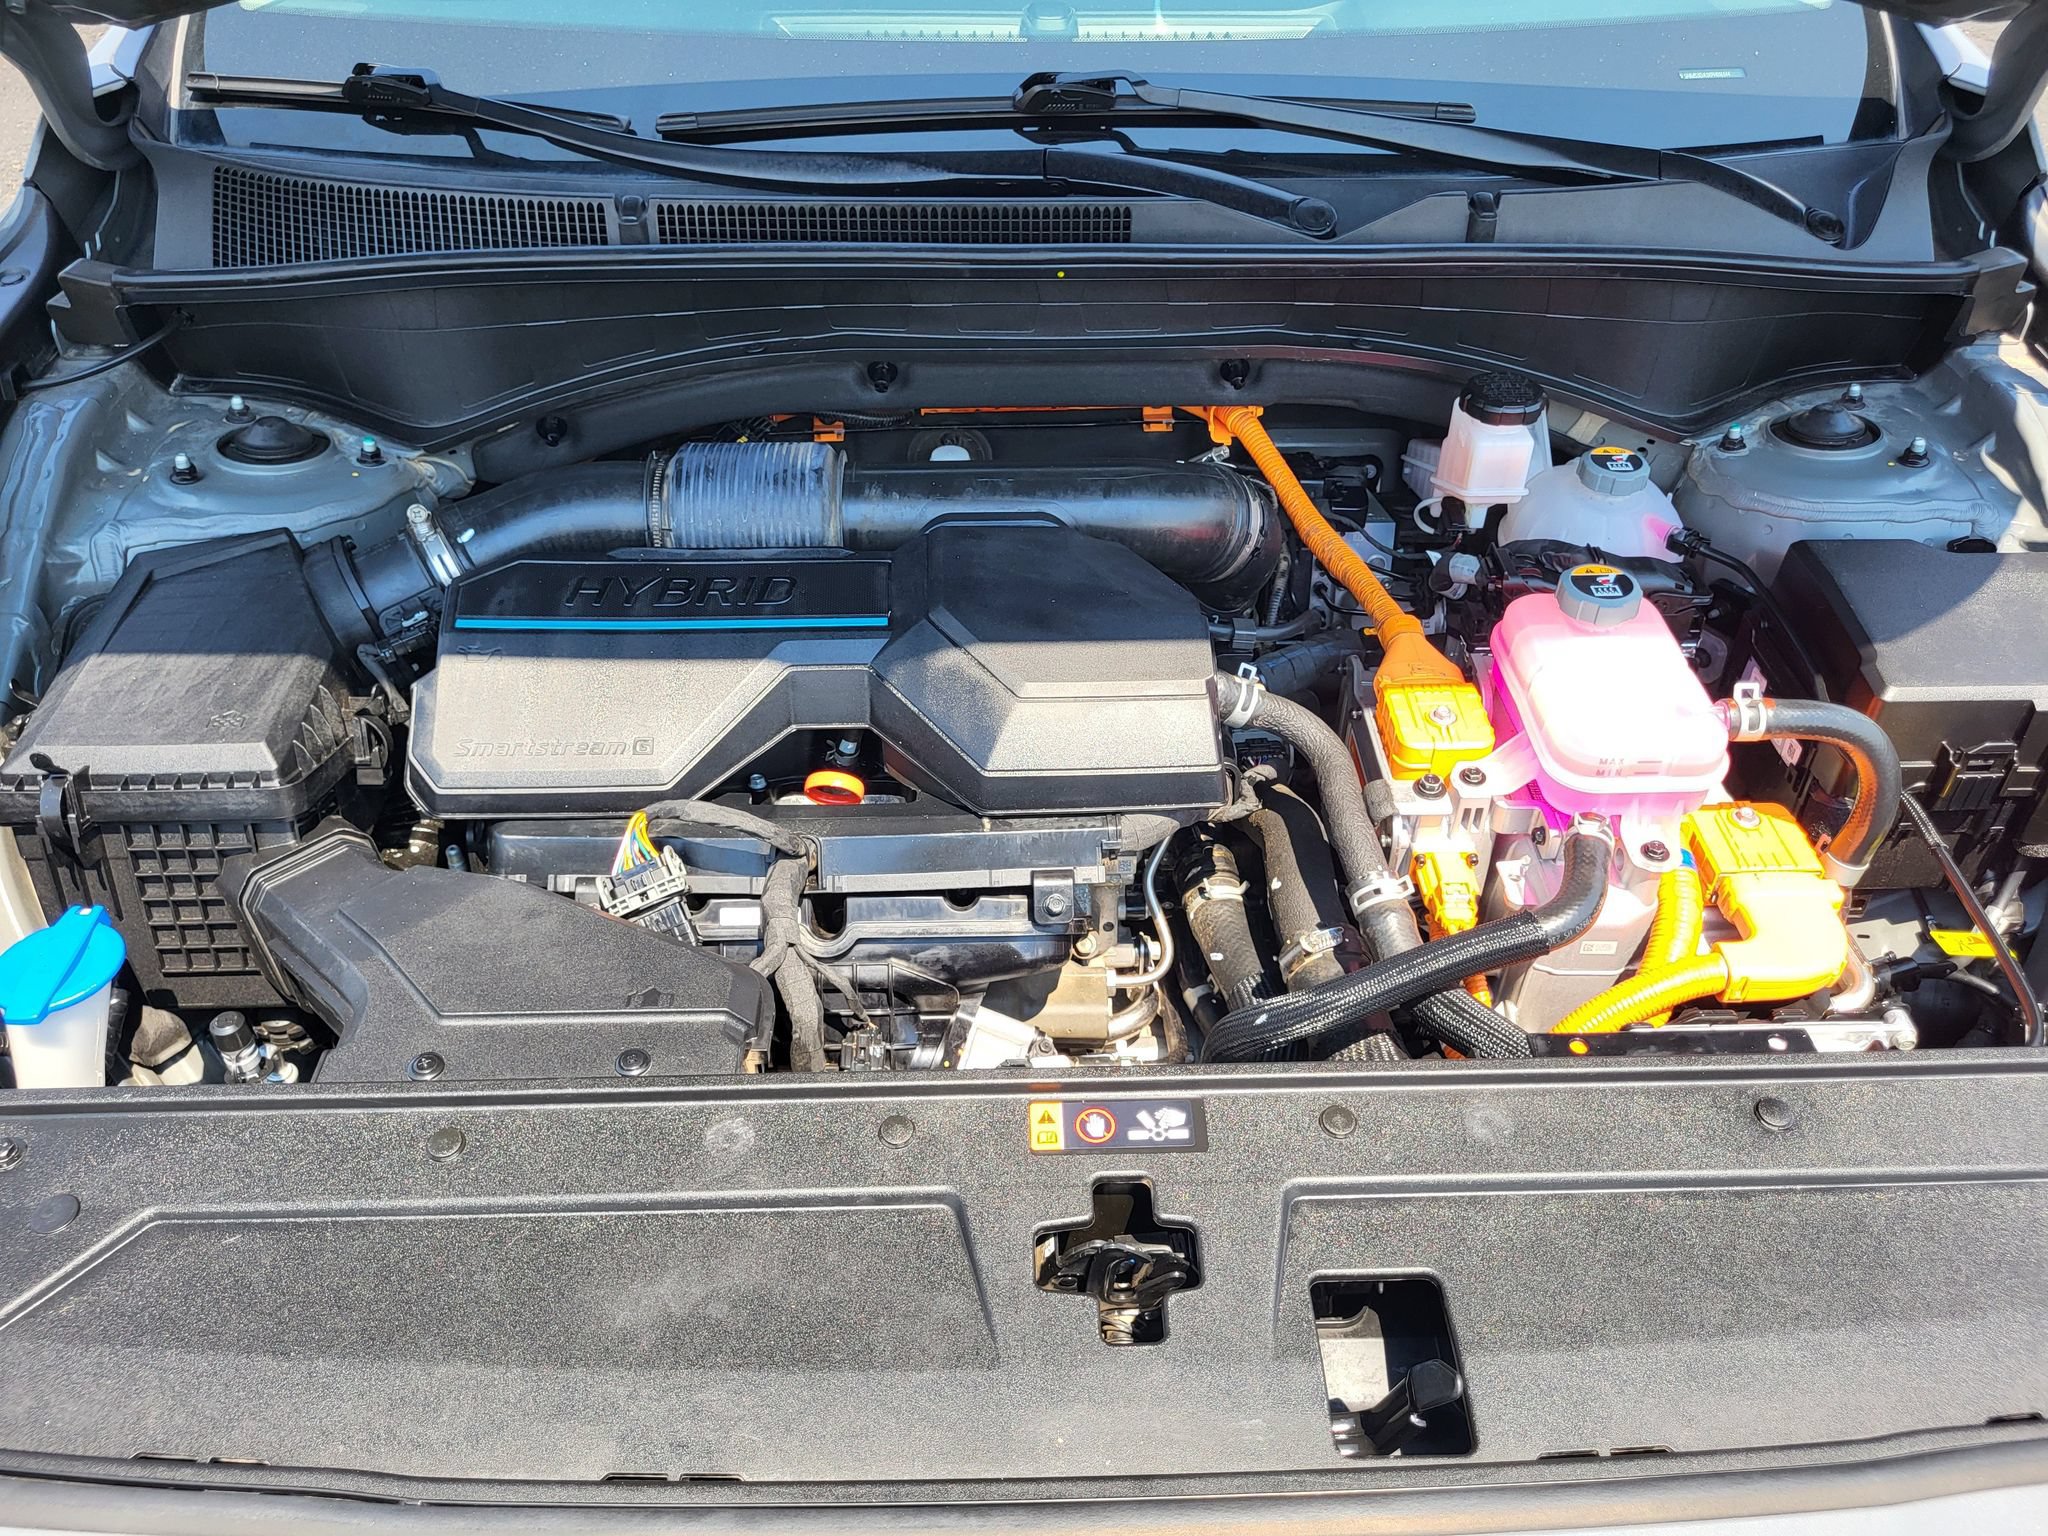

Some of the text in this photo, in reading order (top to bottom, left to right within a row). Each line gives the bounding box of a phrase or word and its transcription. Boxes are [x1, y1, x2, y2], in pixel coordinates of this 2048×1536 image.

[564, 576, 798, 607] HYBRID
[453, 738, 628, 757] Smartstream
[1599, 758, 1625, 766] MAX
[1596, 768, 1623, 777] MIN
